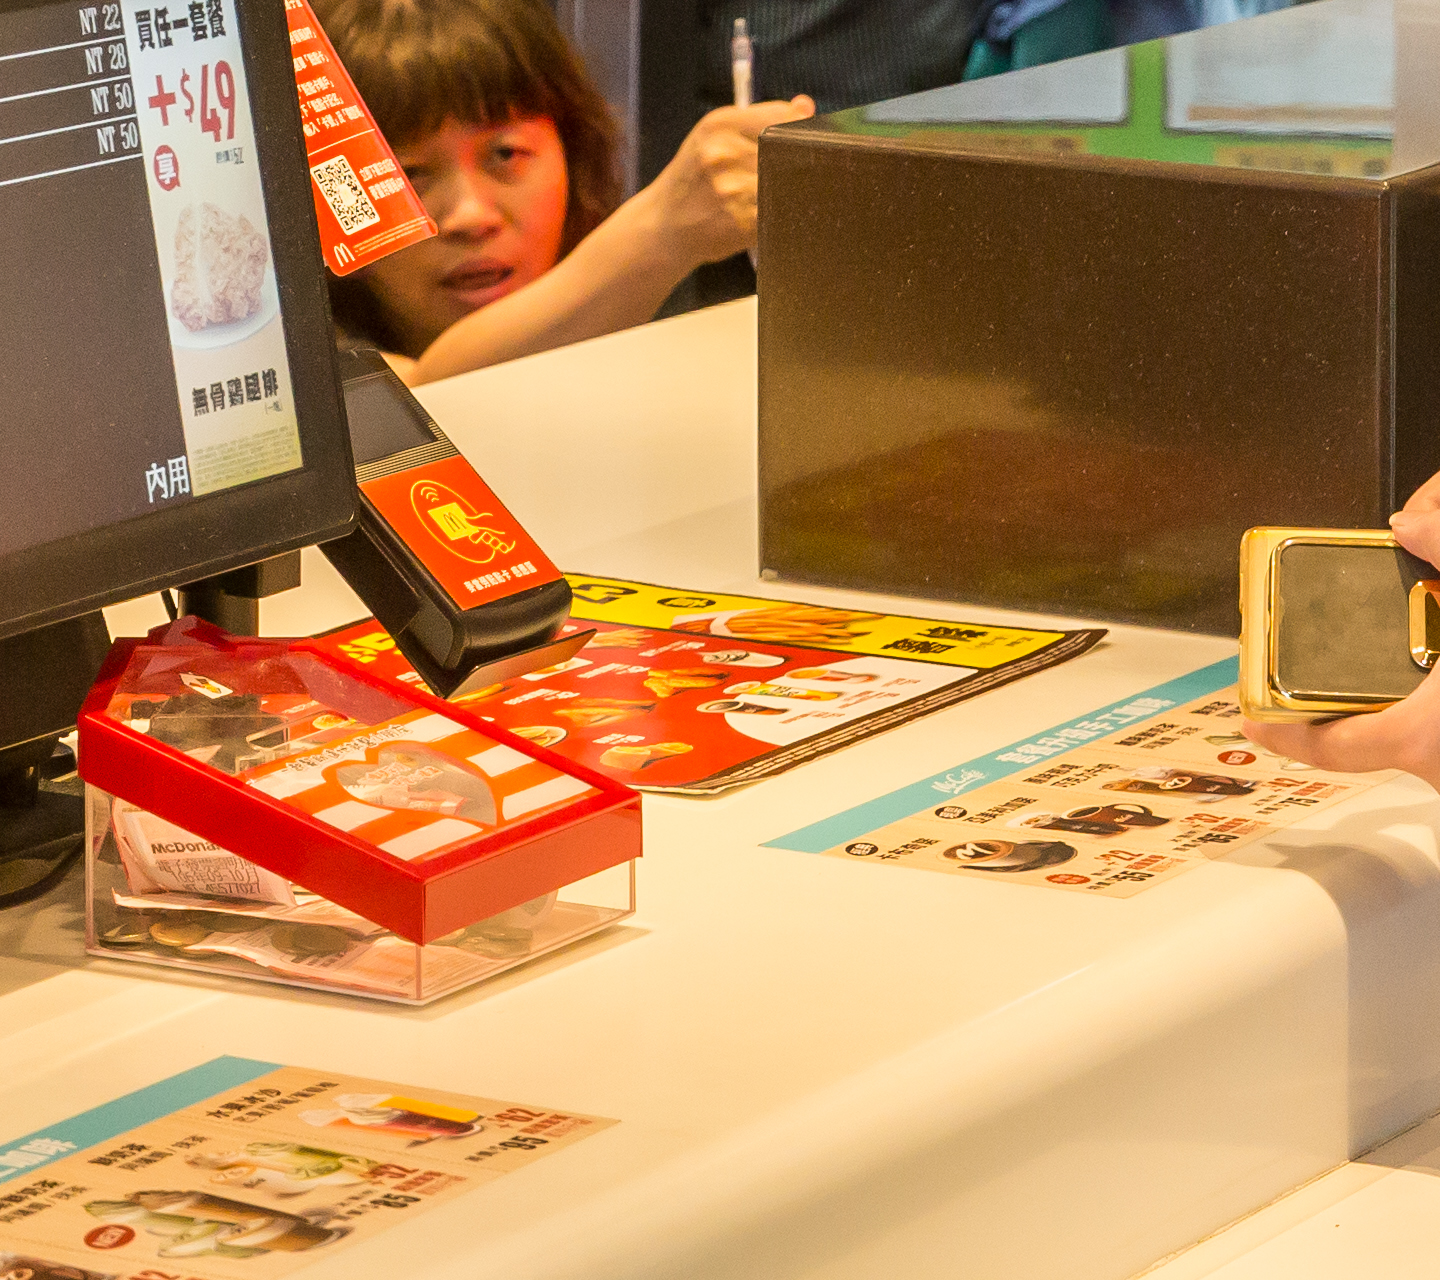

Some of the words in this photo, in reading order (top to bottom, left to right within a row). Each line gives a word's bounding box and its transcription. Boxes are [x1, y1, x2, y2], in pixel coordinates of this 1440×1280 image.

[79, 7, 97, 35] NT
[85, 47, 103, 74] NT
[108, 43, 126, 70] 28
[91, 86, 109, 114] NT
[114, 82, 132, 109] 50
[97, 127, 115, 154] NT
[120, 123, 138, 149] 50
[157, 152, 175, 184] 享
[145, 455, 190, 503] 內用
[995, 696, 1175, 764] 套餐升級手工咖啡
[206, 1087, 282, 1120] 水果冰沙
